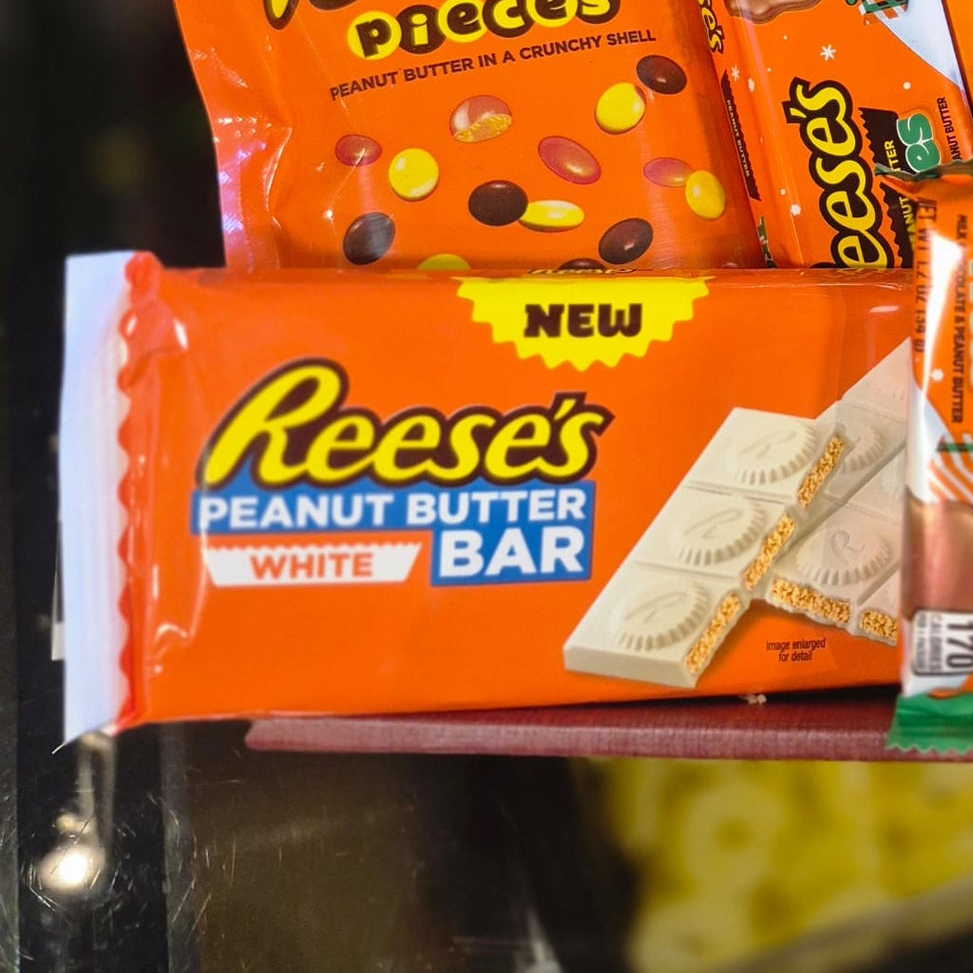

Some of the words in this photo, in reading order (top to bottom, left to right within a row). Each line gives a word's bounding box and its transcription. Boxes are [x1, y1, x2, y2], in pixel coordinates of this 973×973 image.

[330, 71, 399, 101] PEANUT
[403, 58, 473, 82] BUTTER
[478, 52, 498, 68] IN
[502, 50, 516, 64] A
[519, 35, 602, 60] CRUNCHY
[606, 30, 657, 47] SHELL
[936, 97, 955, 132] BUTTER
[946, 135, 962, 160] ANUT
[785, 79, 888, 268] eese's
[956, 214, 968, 239] MILK
[524, 303, 642, 337] NEW
[952, 326, 965, 373] PEANUT
[951, 377, 965, 424] BUTTER
[199, 360, 610, 487] Reese's
[201, 494, 393, 530] PEANUT
[406, 487, 585, 525] BUTTER
[250, 552, 373, 580] WHITE
[438, 526, 585, 578] BAR
[779, 651, 789, 661] for
